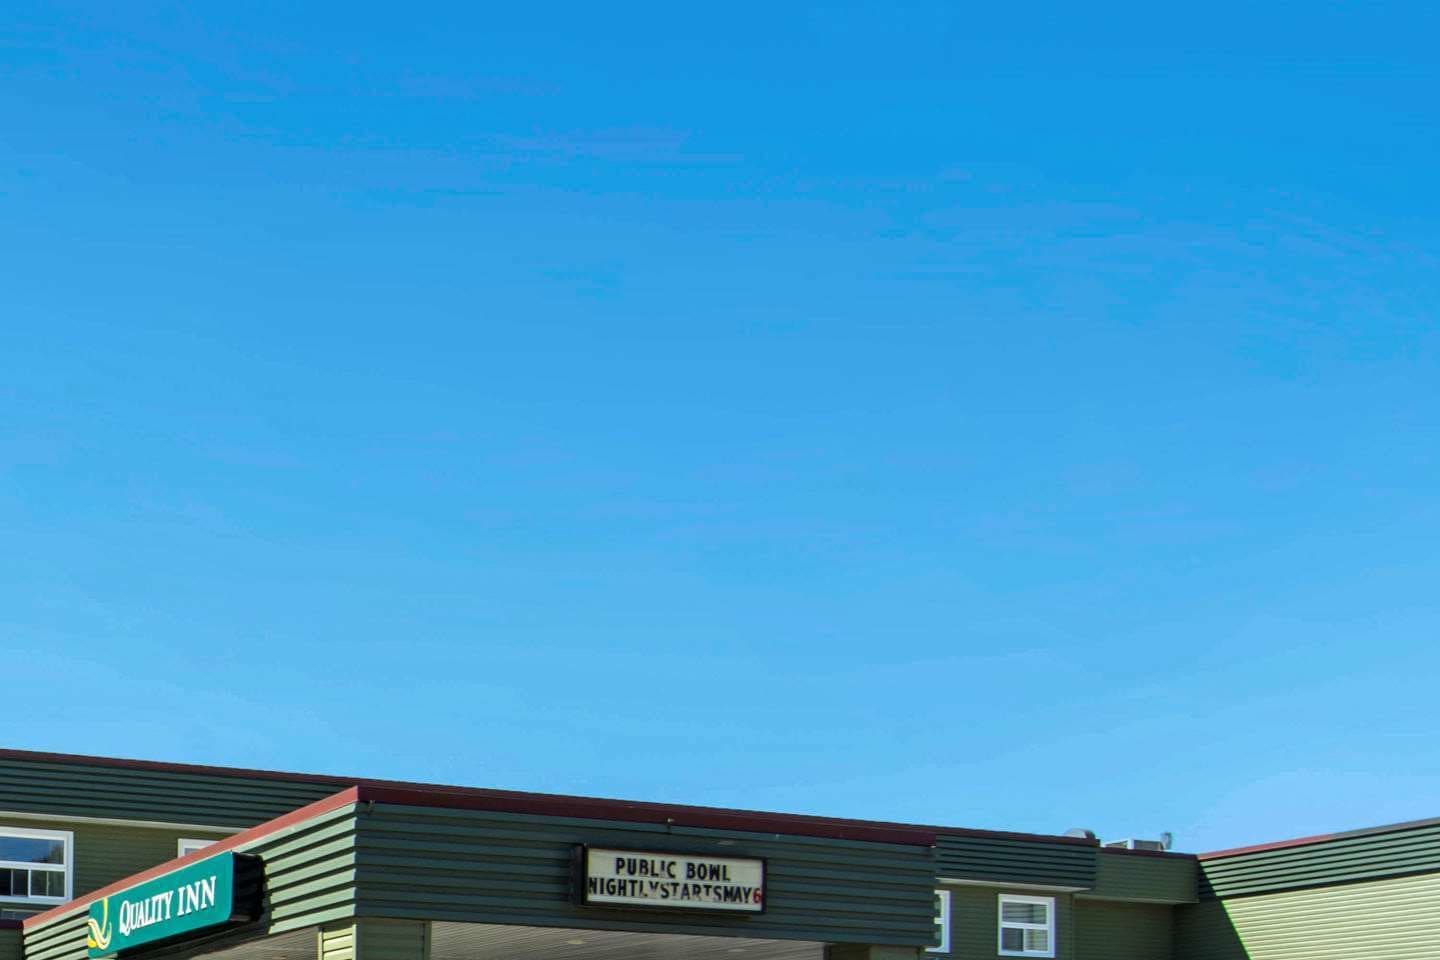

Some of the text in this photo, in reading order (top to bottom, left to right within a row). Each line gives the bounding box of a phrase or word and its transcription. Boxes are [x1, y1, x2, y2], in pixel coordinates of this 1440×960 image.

[615, 857, 731, 881] PUBLIC BOWL
[119, 876, 216, 936] QUALITY INN
